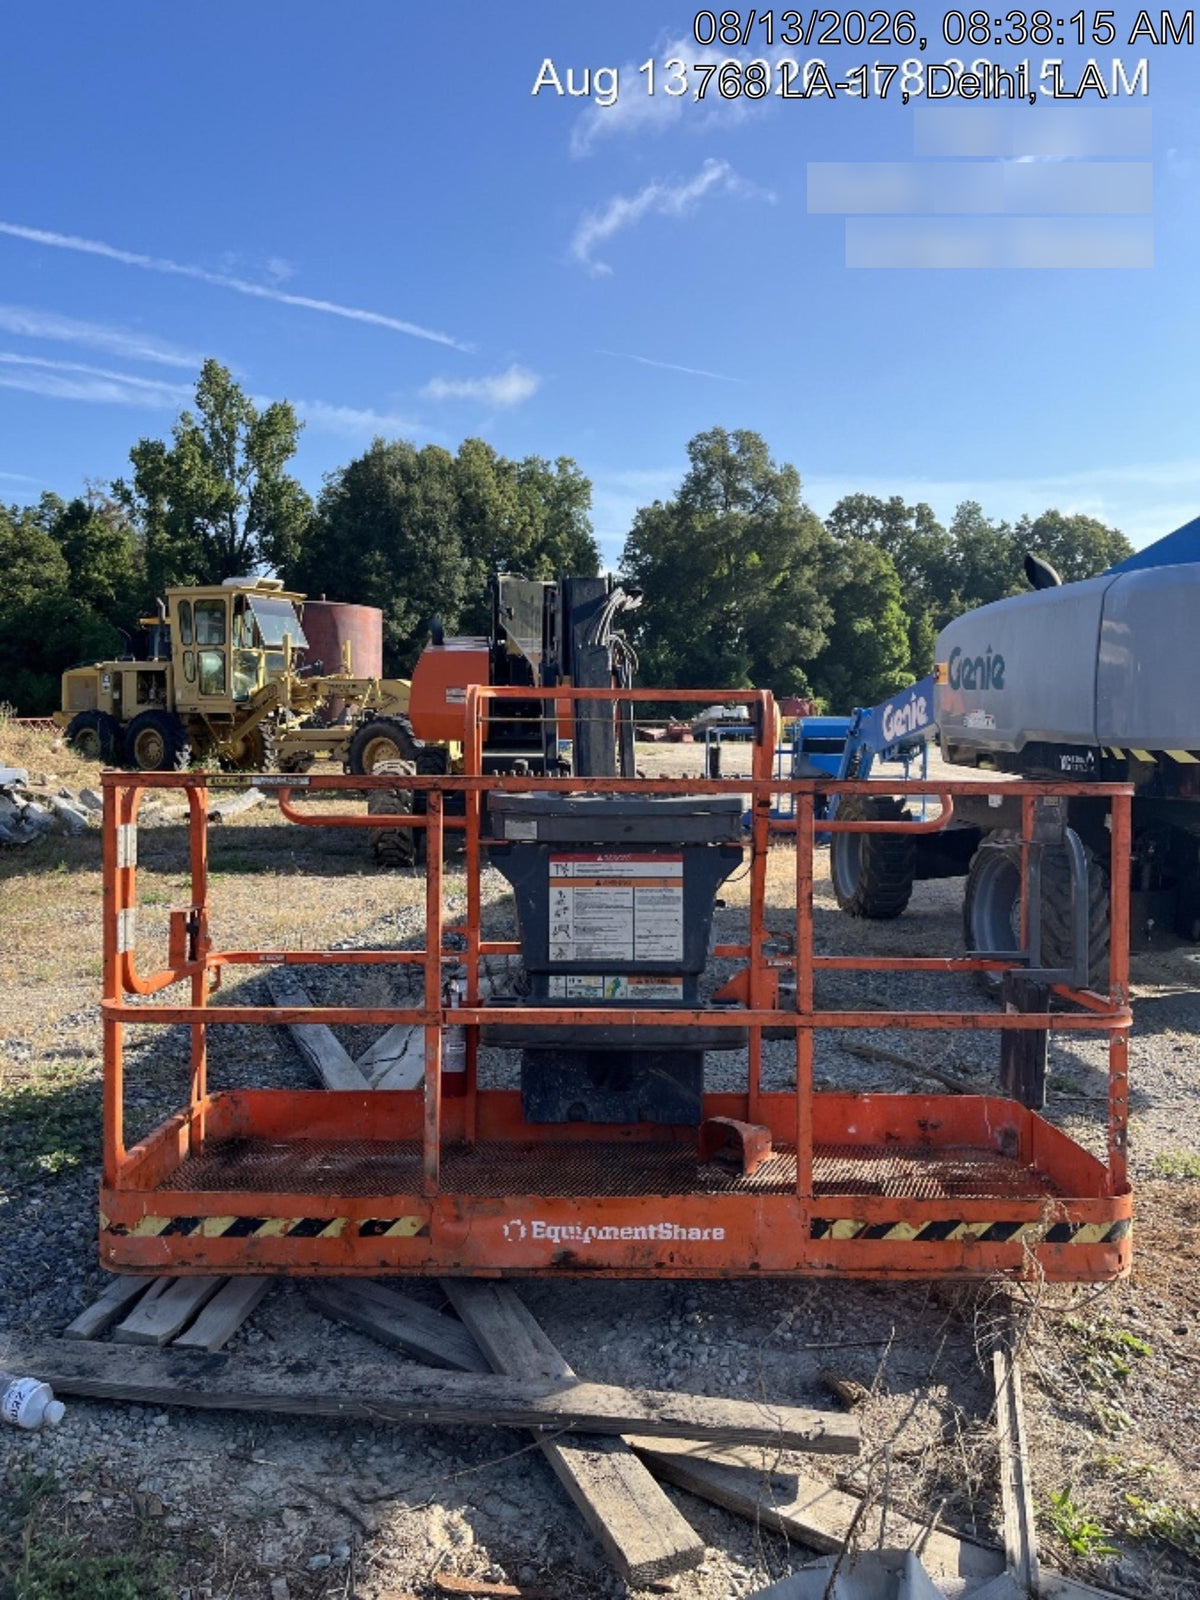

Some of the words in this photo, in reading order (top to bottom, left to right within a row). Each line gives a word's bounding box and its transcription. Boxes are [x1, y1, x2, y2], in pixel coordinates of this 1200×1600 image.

[949, 643, 1006, 691] Genie
[882, 692, 929, 742] Genie
[531, 1220, 726, 1244] EquipmentShare
